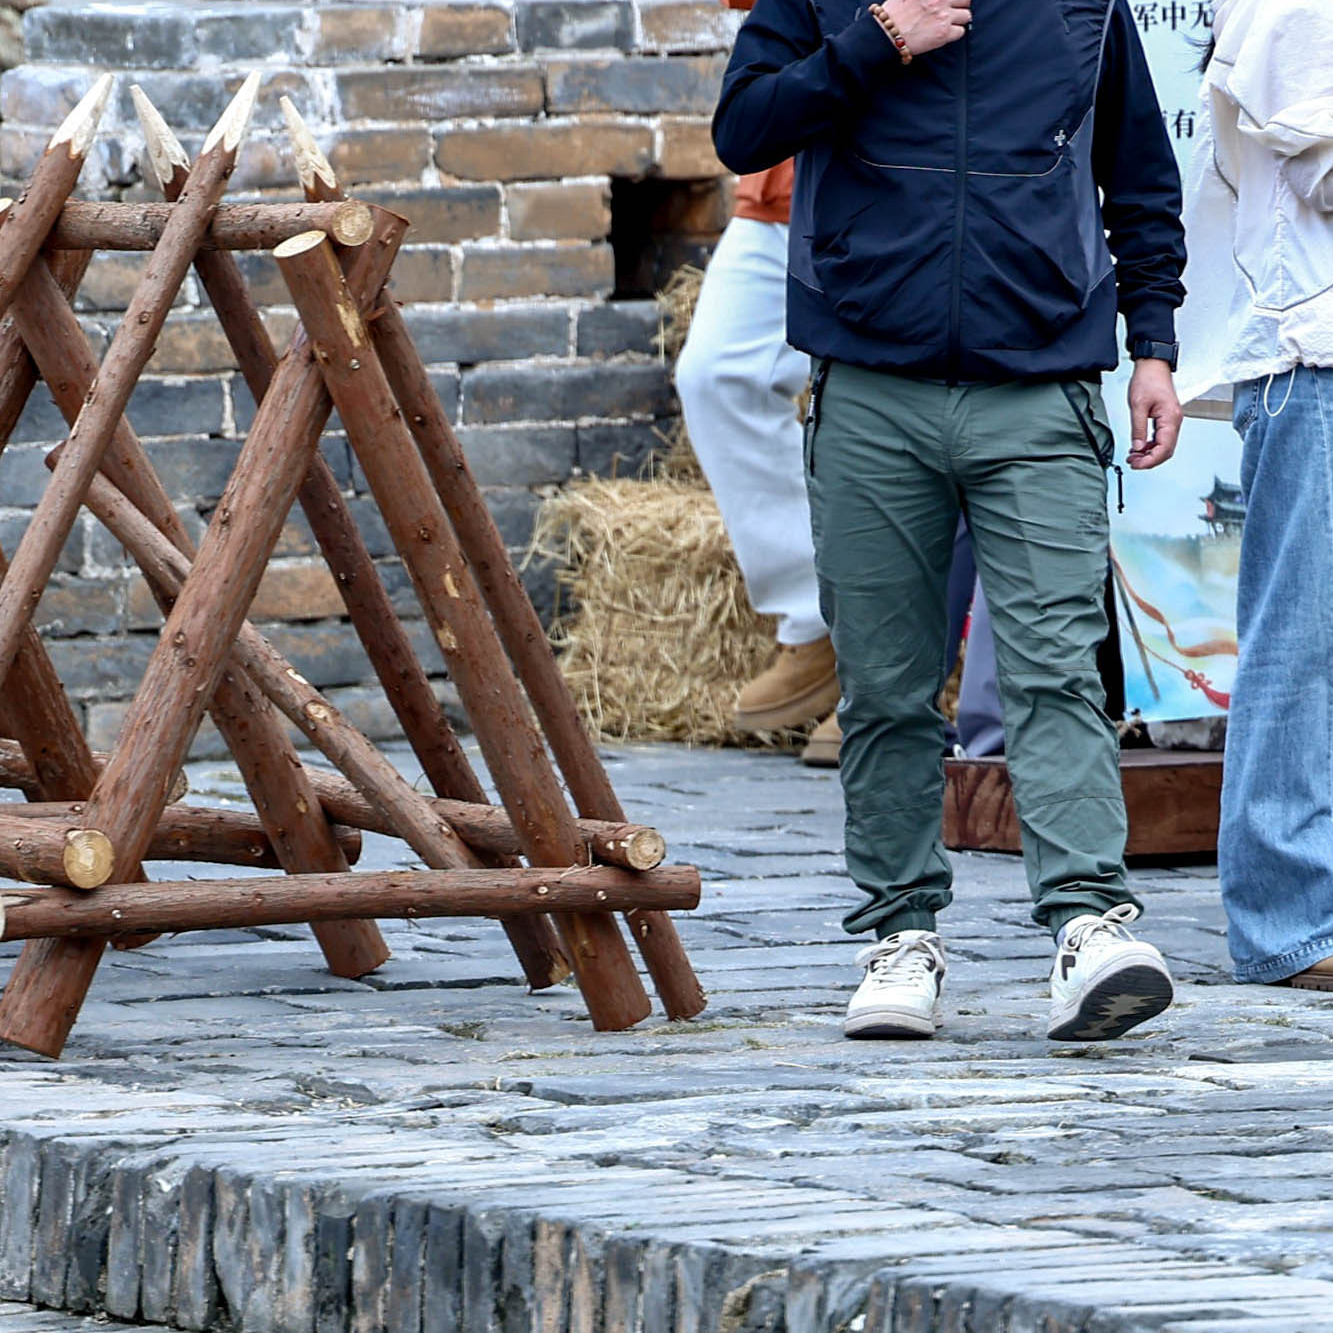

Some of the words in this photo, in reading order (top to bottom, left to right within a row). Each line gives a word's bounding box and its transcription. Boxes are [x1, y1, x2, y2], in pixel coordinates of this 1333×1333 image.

[1133, 0, 1214, 32] 军中无
[1162, 108, 1197, 139] 有
